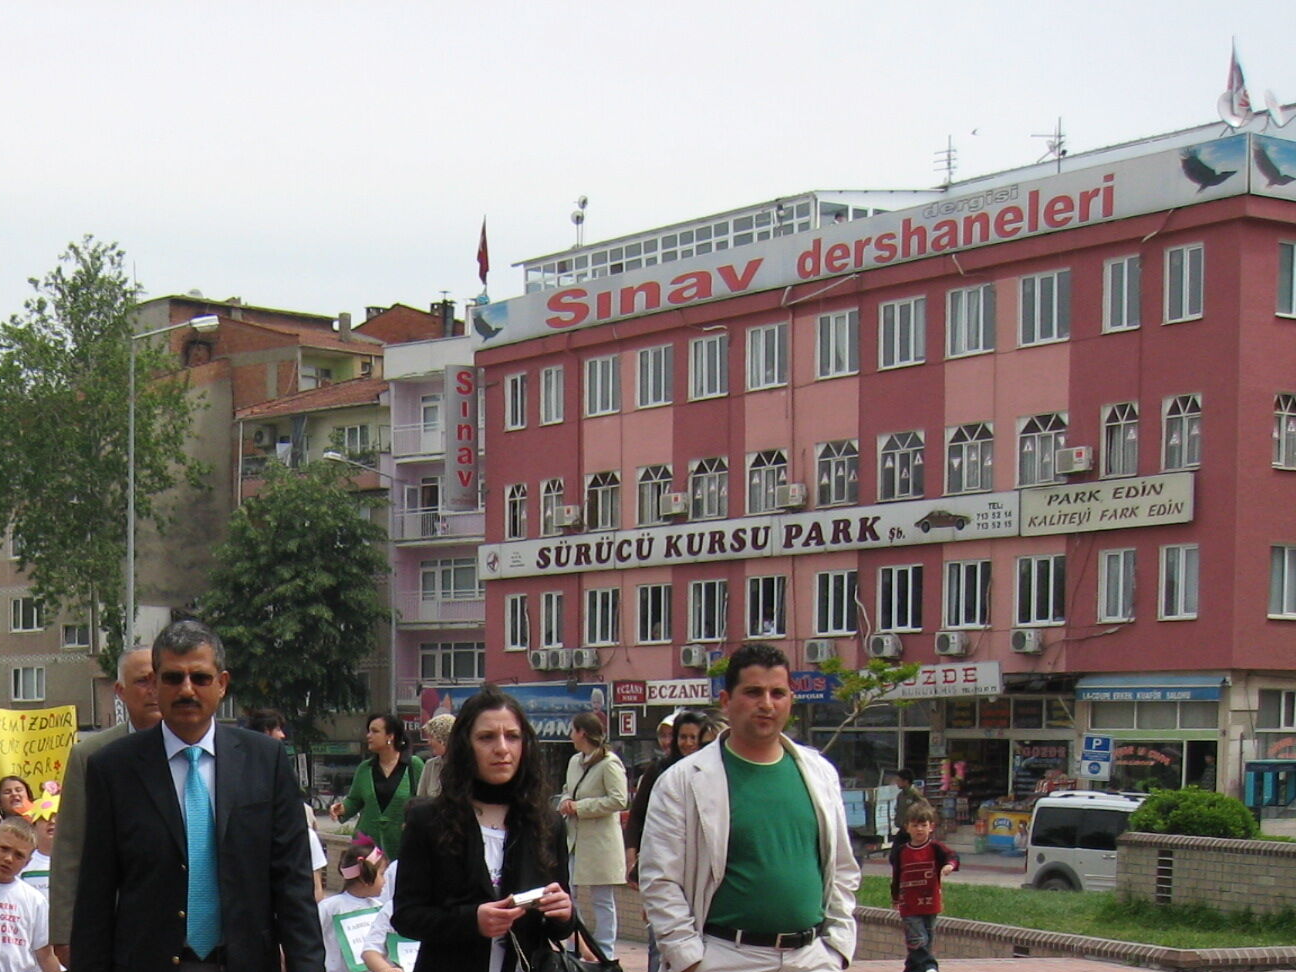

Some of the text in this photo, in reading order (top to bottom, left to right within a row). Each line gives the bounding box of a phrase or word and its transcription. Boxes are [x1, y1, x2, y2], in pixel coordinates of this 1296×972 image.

[922, 184, 1019, 219] dergisi
[545, 173, 1115, 329] Sınav dershaneleri
[1047, 482, 1164, 506] PARK EDİN
[1099, 506, 1140, 522] FARK
[1147, 500, 1185, 517] EDİN
[536, 533, 655, 570] SÜRÜCÜ
[664, 526, 771, 558] KURSU
[782, 516, 881, 549] PARK
[647, 683, 710, 700] ECZANE
[622, 713, 633, 732] E
[1092, 738, 1102, 749] P
